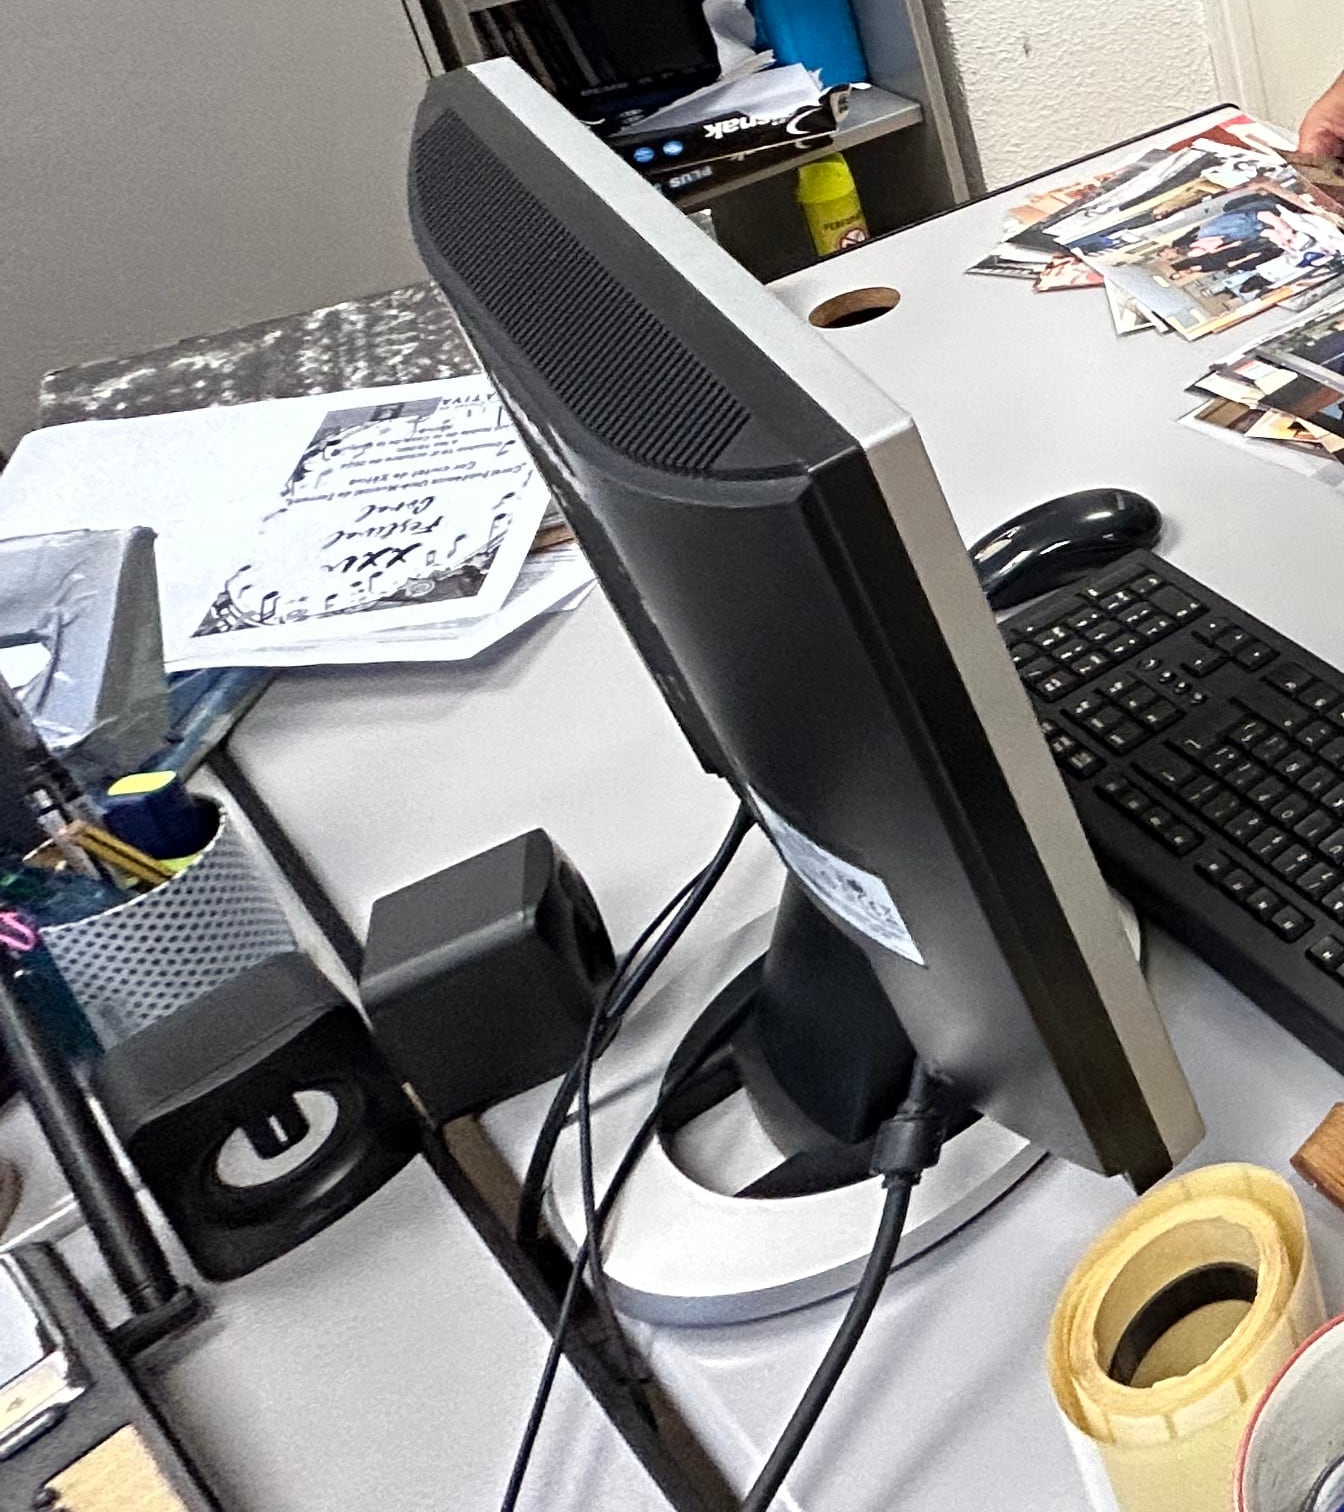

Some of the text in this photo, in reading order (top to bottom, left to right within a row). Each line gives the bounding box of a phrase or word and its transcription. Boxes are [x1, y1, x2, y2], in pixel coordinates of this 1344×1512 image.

[669, 166, 713, 188] PLUS
[355, 495, 436, 523] Coral
[321, 515, 445, 550] Festival
